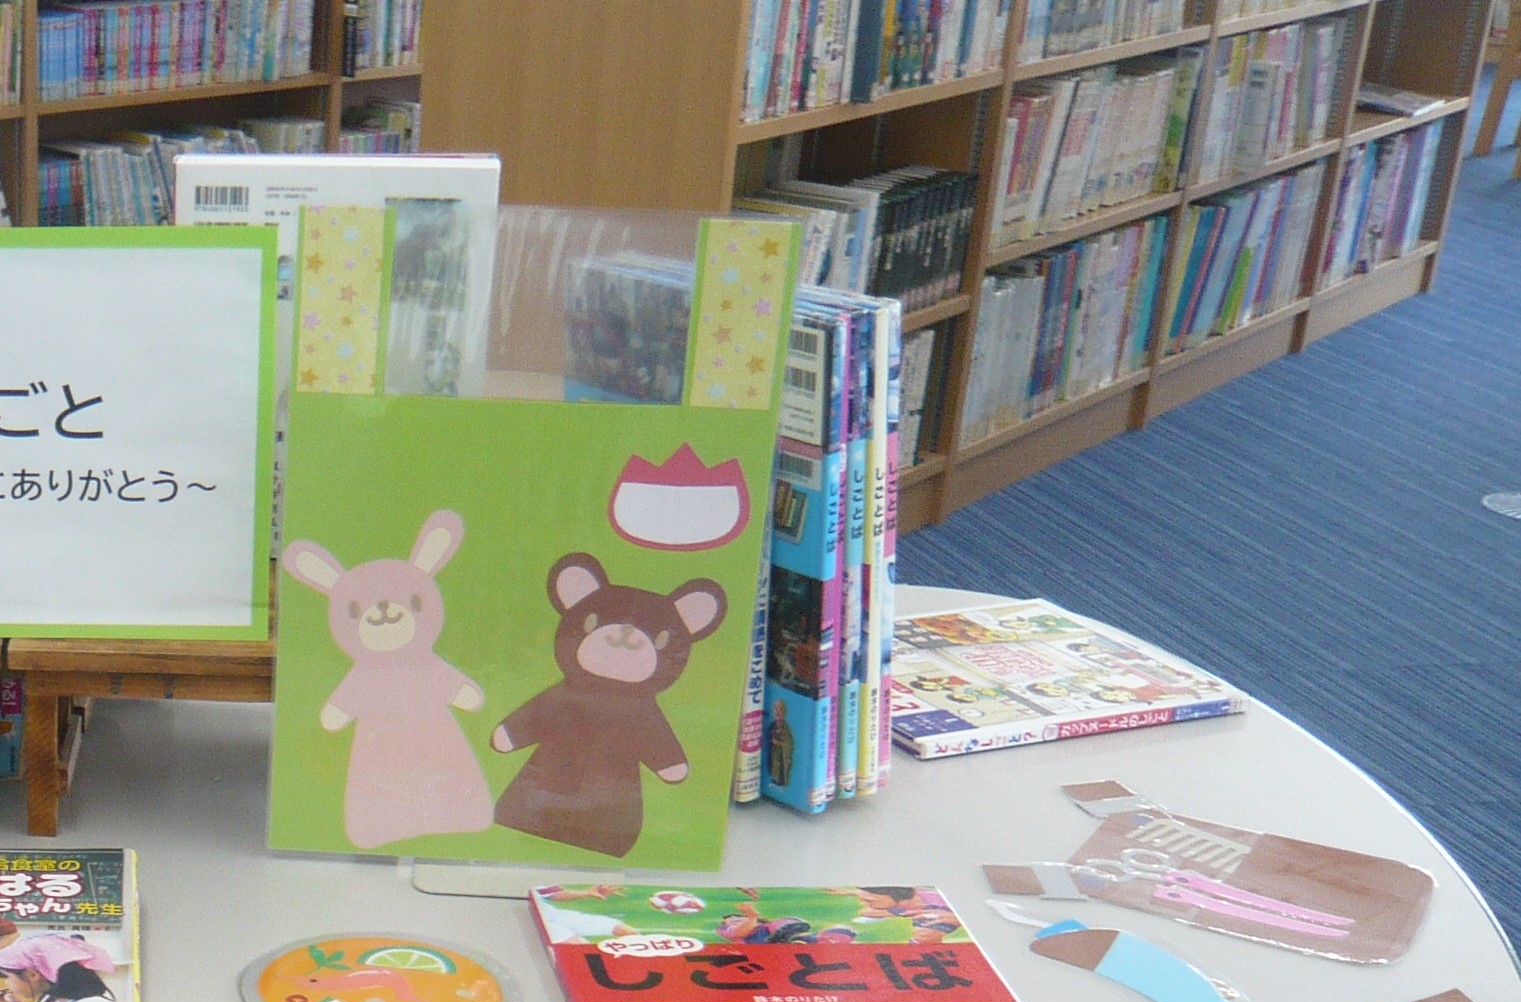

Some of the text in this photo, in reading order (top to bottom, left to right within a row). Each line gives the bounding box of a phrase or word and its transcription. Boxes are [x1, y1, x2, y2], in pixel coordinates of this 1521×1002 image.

[851, 470, 864, 540] しごとば
[873, 468, 884, 537] しごとば
[584, 950, 974, 992] しごとば
[603, 937, 695, 952] やっぱり
